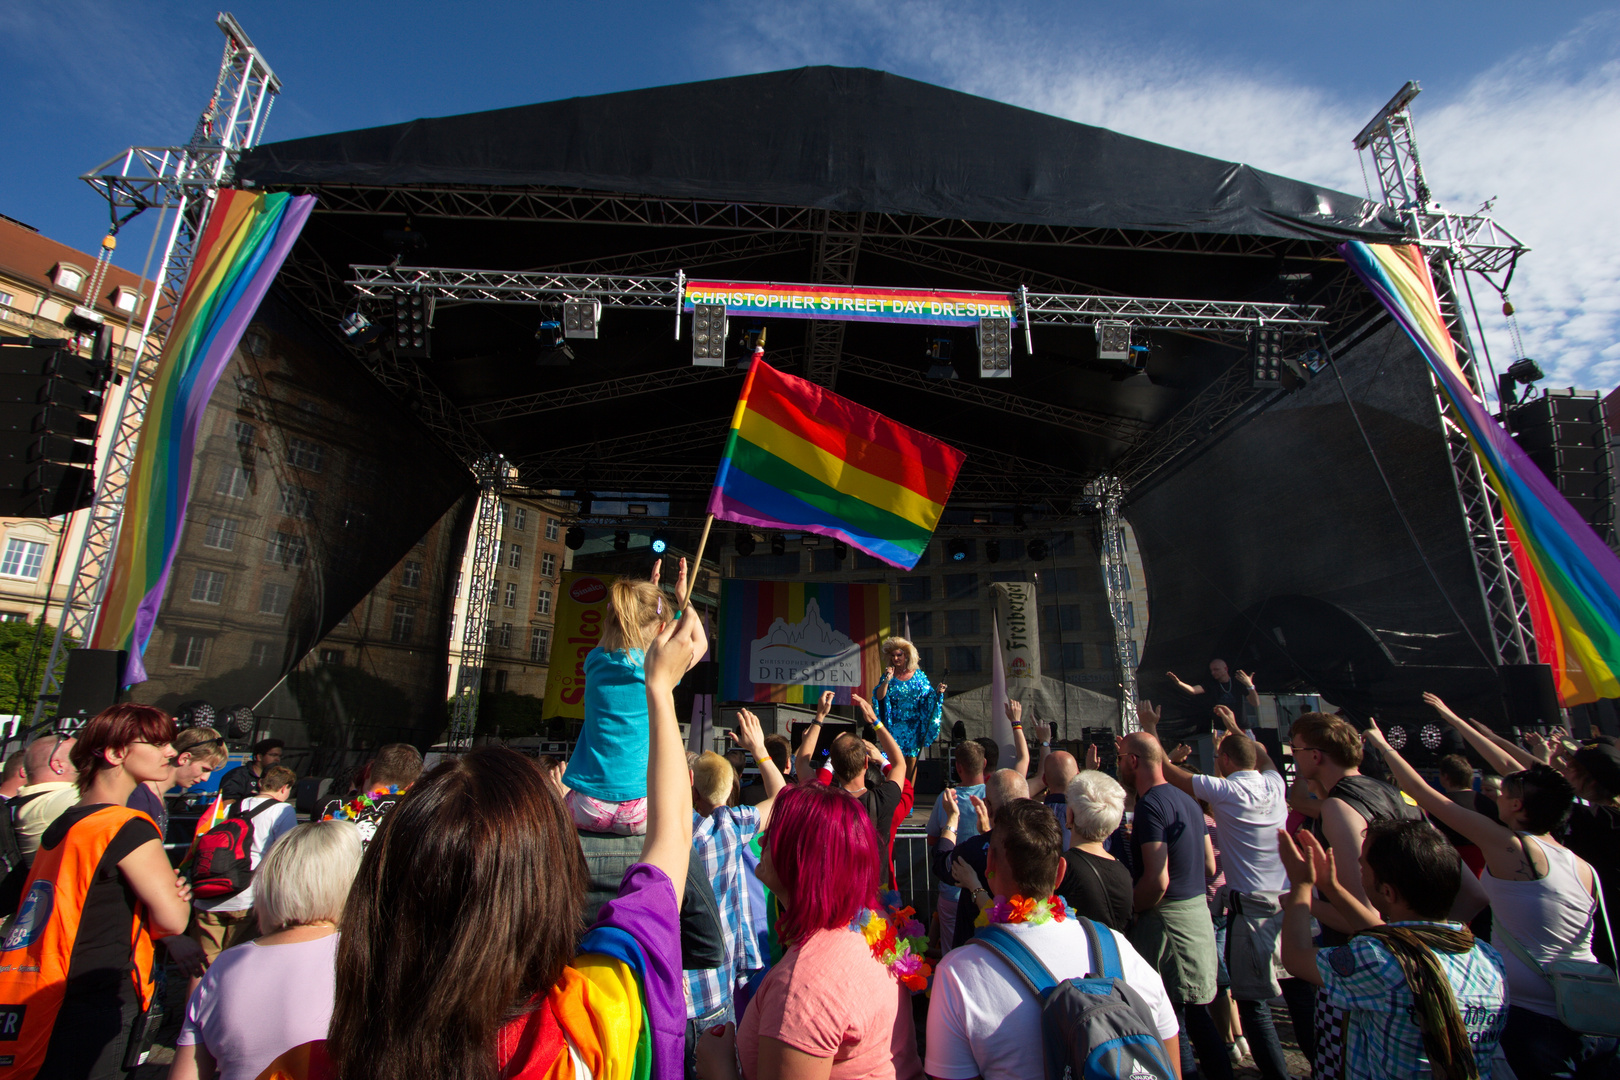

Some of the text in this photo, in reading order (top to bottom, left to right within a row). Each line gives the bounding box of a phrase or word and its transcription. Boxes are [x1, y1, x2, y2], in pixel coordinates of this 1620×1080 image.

[690, 291, 1013, 317] CHRISTOPHER STREET DAY DRESDEN
[572, 583, 605, 598] Sinalco
[1006, 583, 1029, 651] Freiberger
[759, 667, 853, 682] DRESDEN
